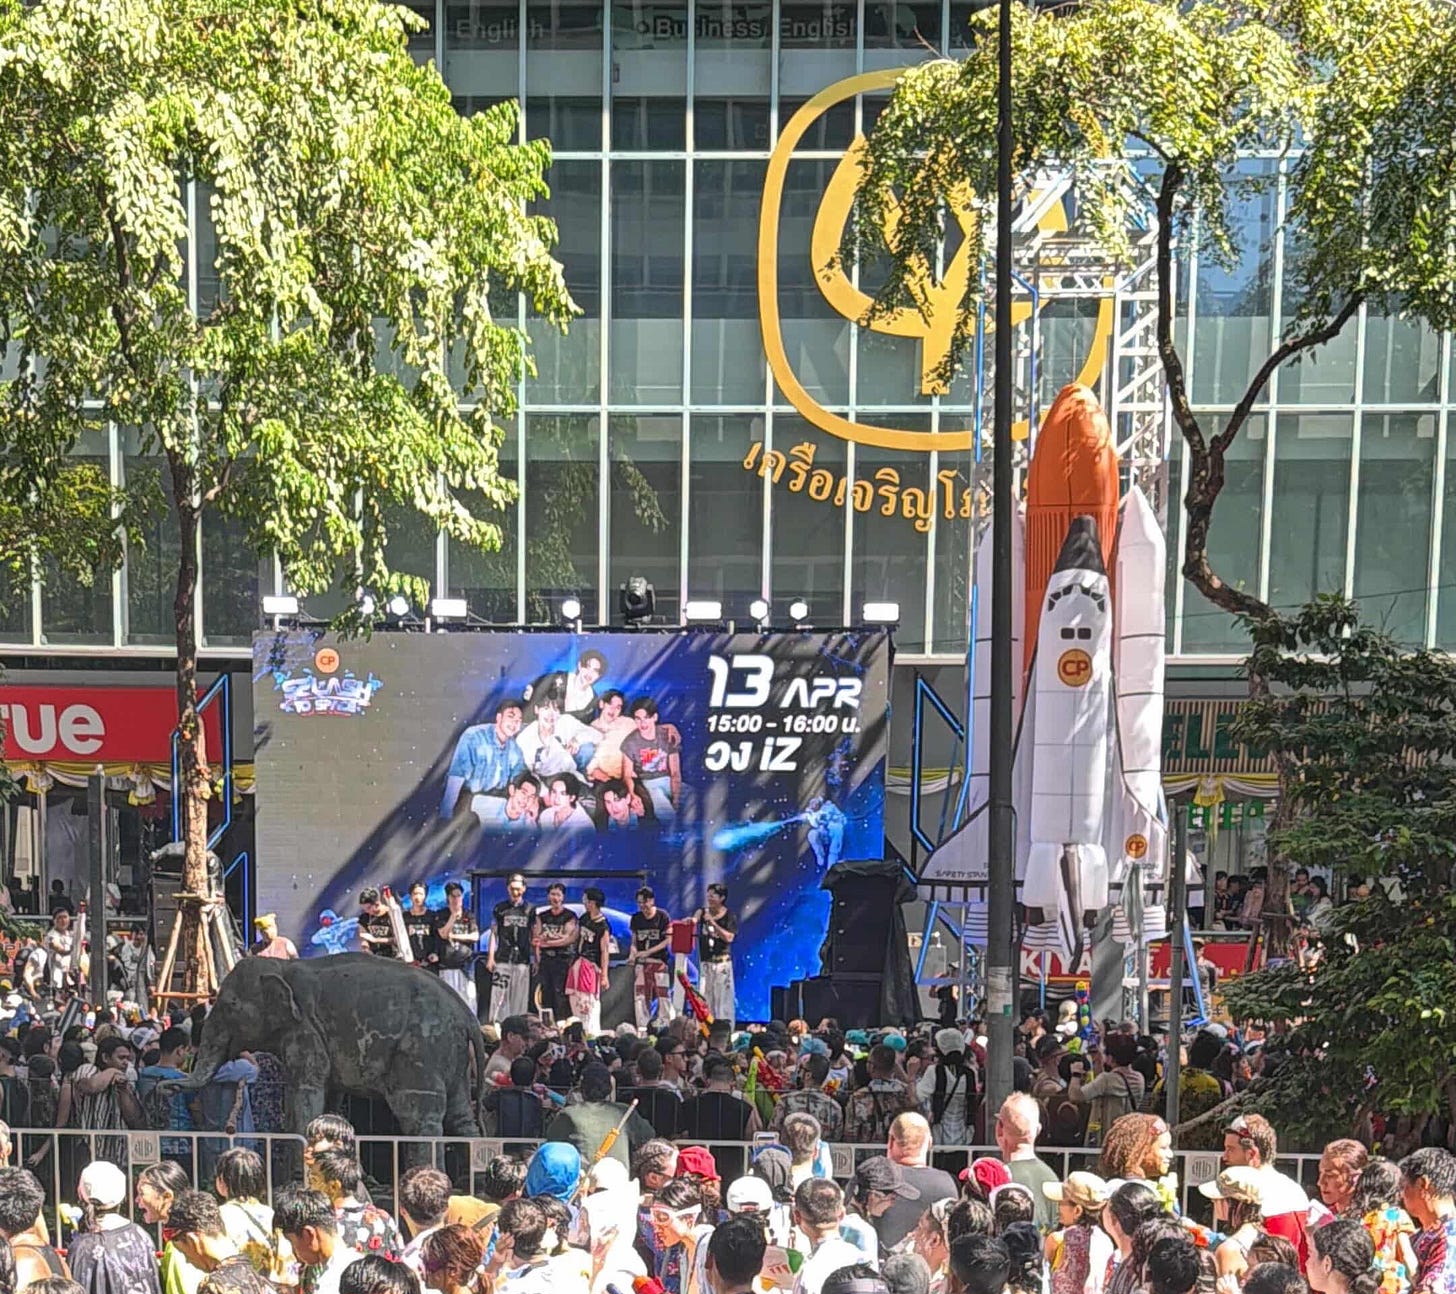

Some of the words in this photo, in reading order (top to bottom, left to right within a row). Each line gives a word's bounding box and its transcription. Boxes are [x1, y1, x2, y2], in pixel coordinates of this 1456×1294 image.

[455, 18, 545, 43] Englih
[655, 17, 761, 38] Buiness
[707, 654, 775, 708] 13
[779, 677, 862, 709] APR
[707, 714, 763, 733] 15:00
[782, 714, 838, 734] 16:00
